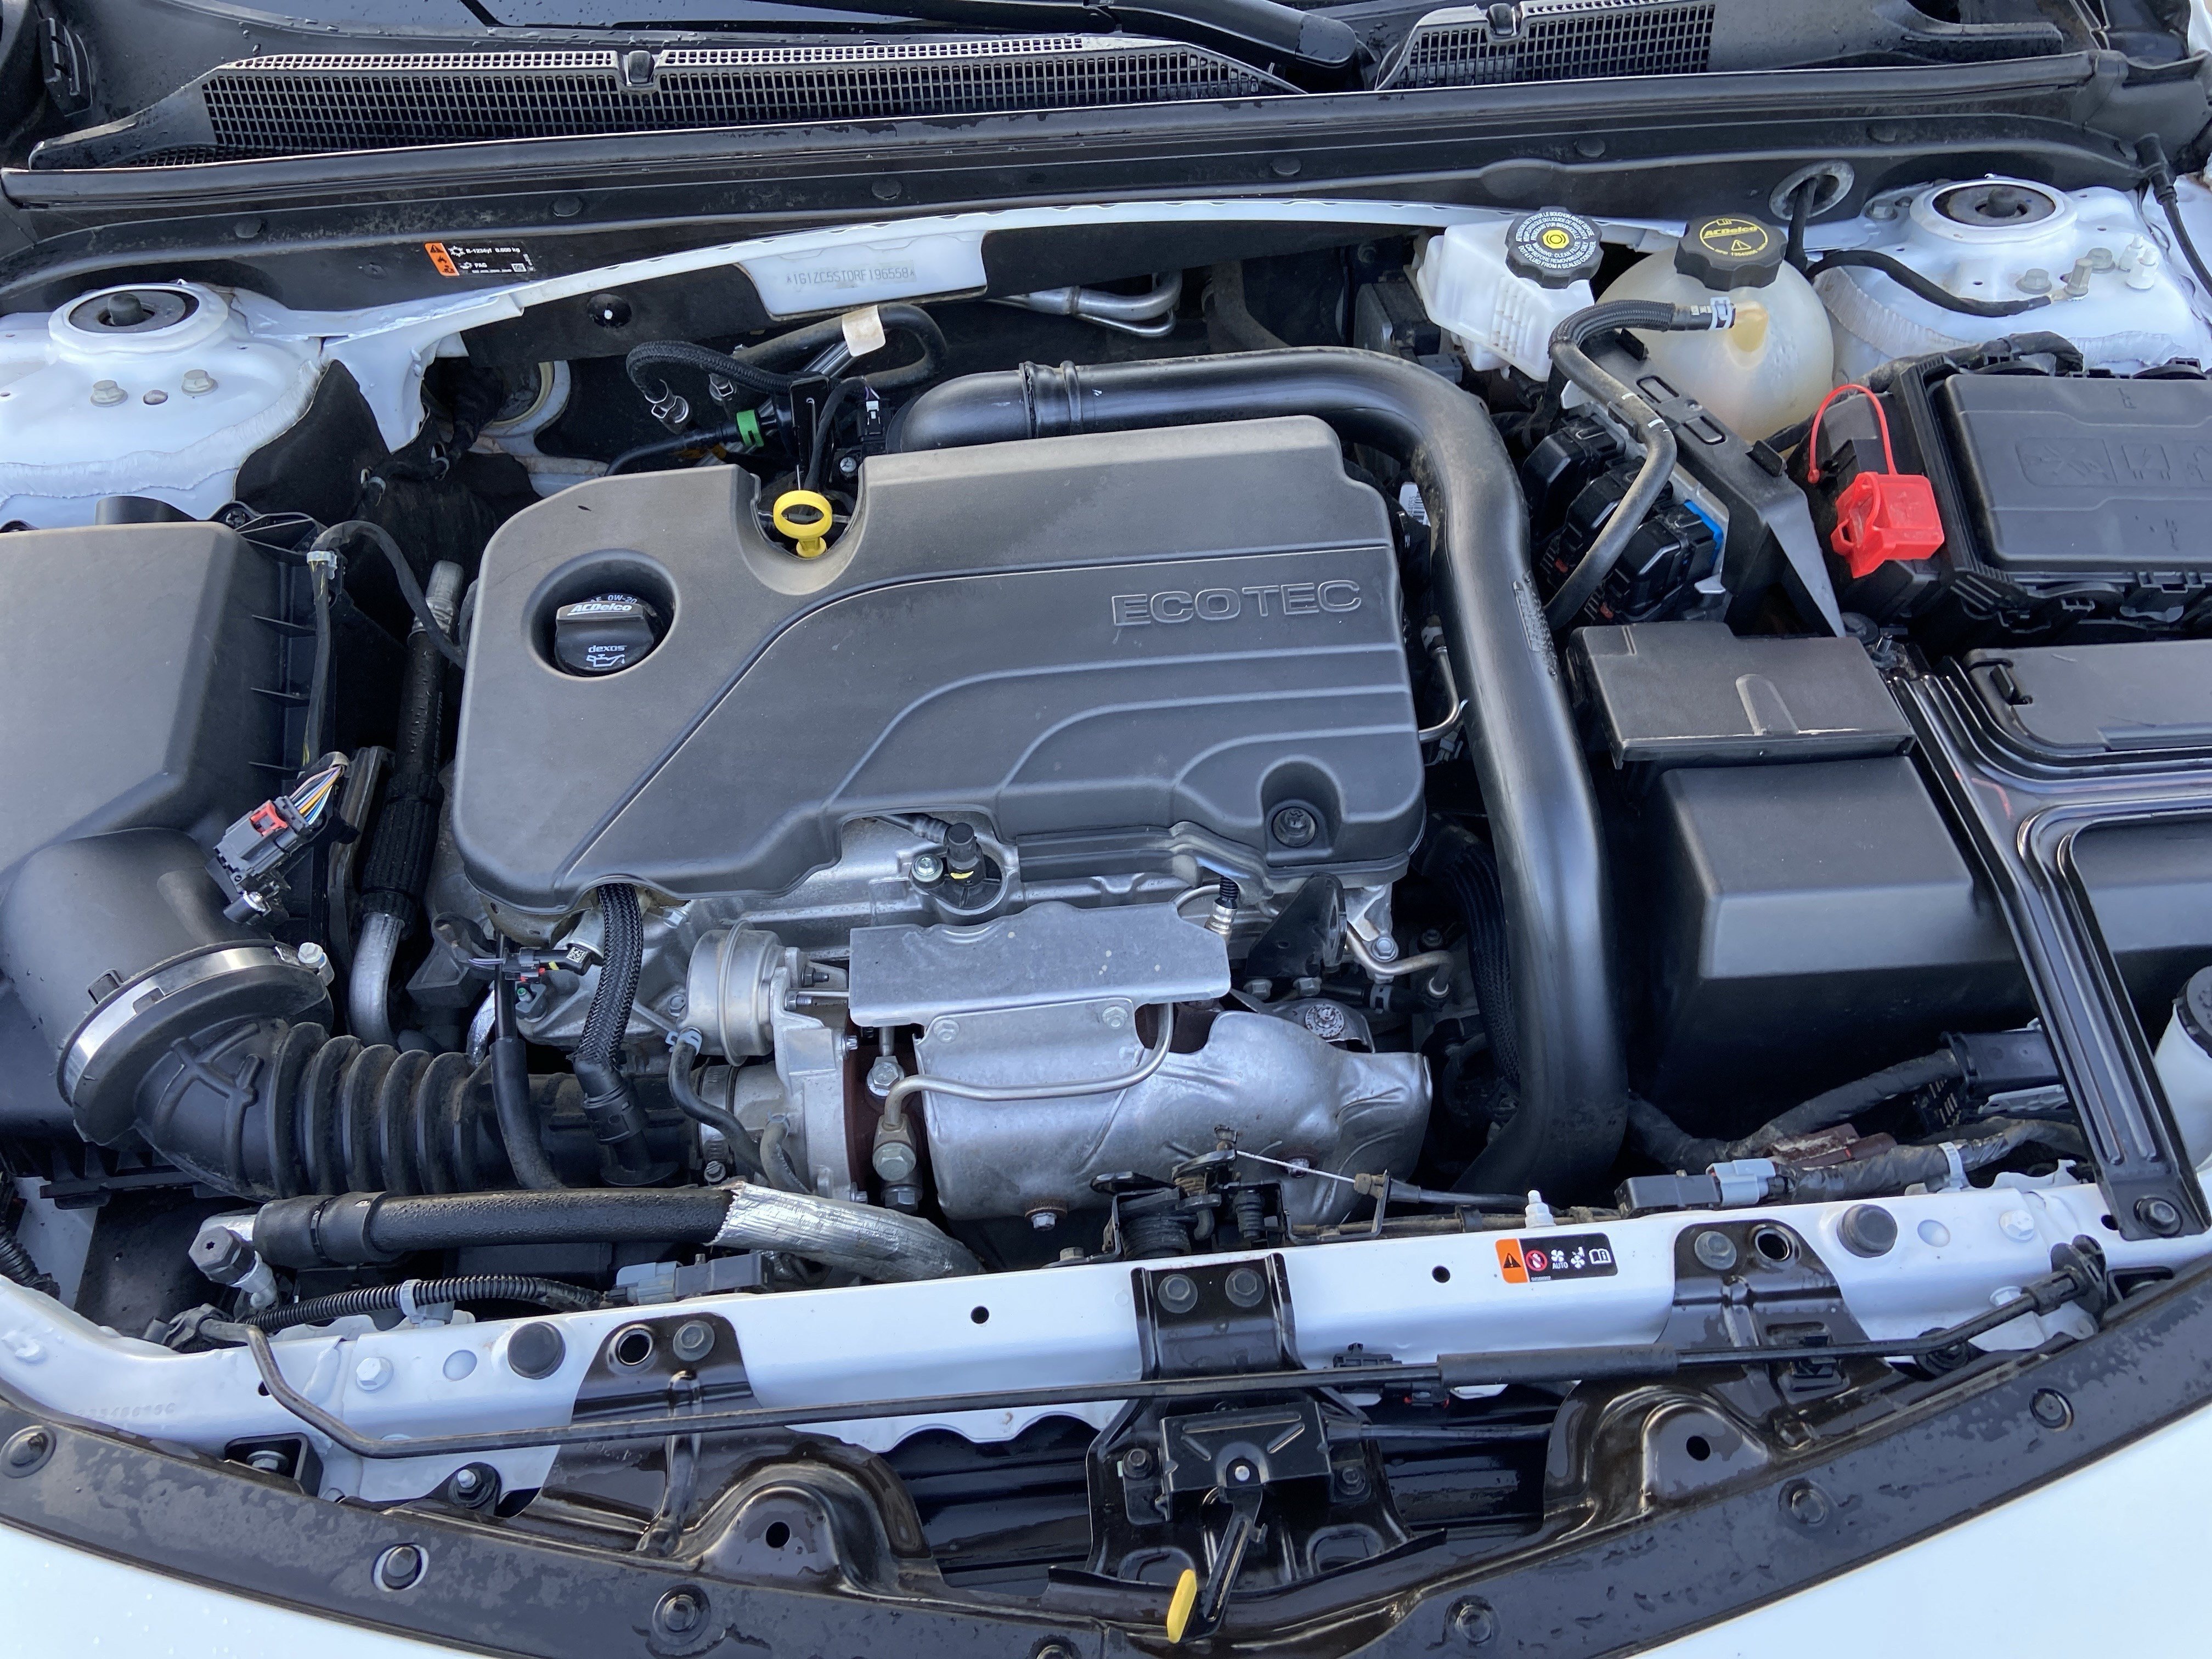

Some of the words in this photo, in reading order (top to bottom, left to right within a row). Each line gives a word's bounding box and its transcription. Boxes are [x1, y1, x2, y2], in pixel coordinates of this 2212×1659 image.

[1549, 211, 1571, 219] BOUCHON
[1571, 215, 1585, 225] AVANT
[1703, 226, 1758, 238] ACDelco
[1525, 244, 1534, 252] CAP
[1531, 251, 1550, 262] BEFORE
[1569, 241, 1581, 254] FILLER
[1526, 254, 1542, 264] FLUID
[1561, 259, 1582, 269] SEALED
[607, 594, 638, 604] 0W-20
[1111, 579, 1362, 627] ECOTEC
[569, 603, 633, 614] ACDelco
[588, 645, 628, 653] dexos
